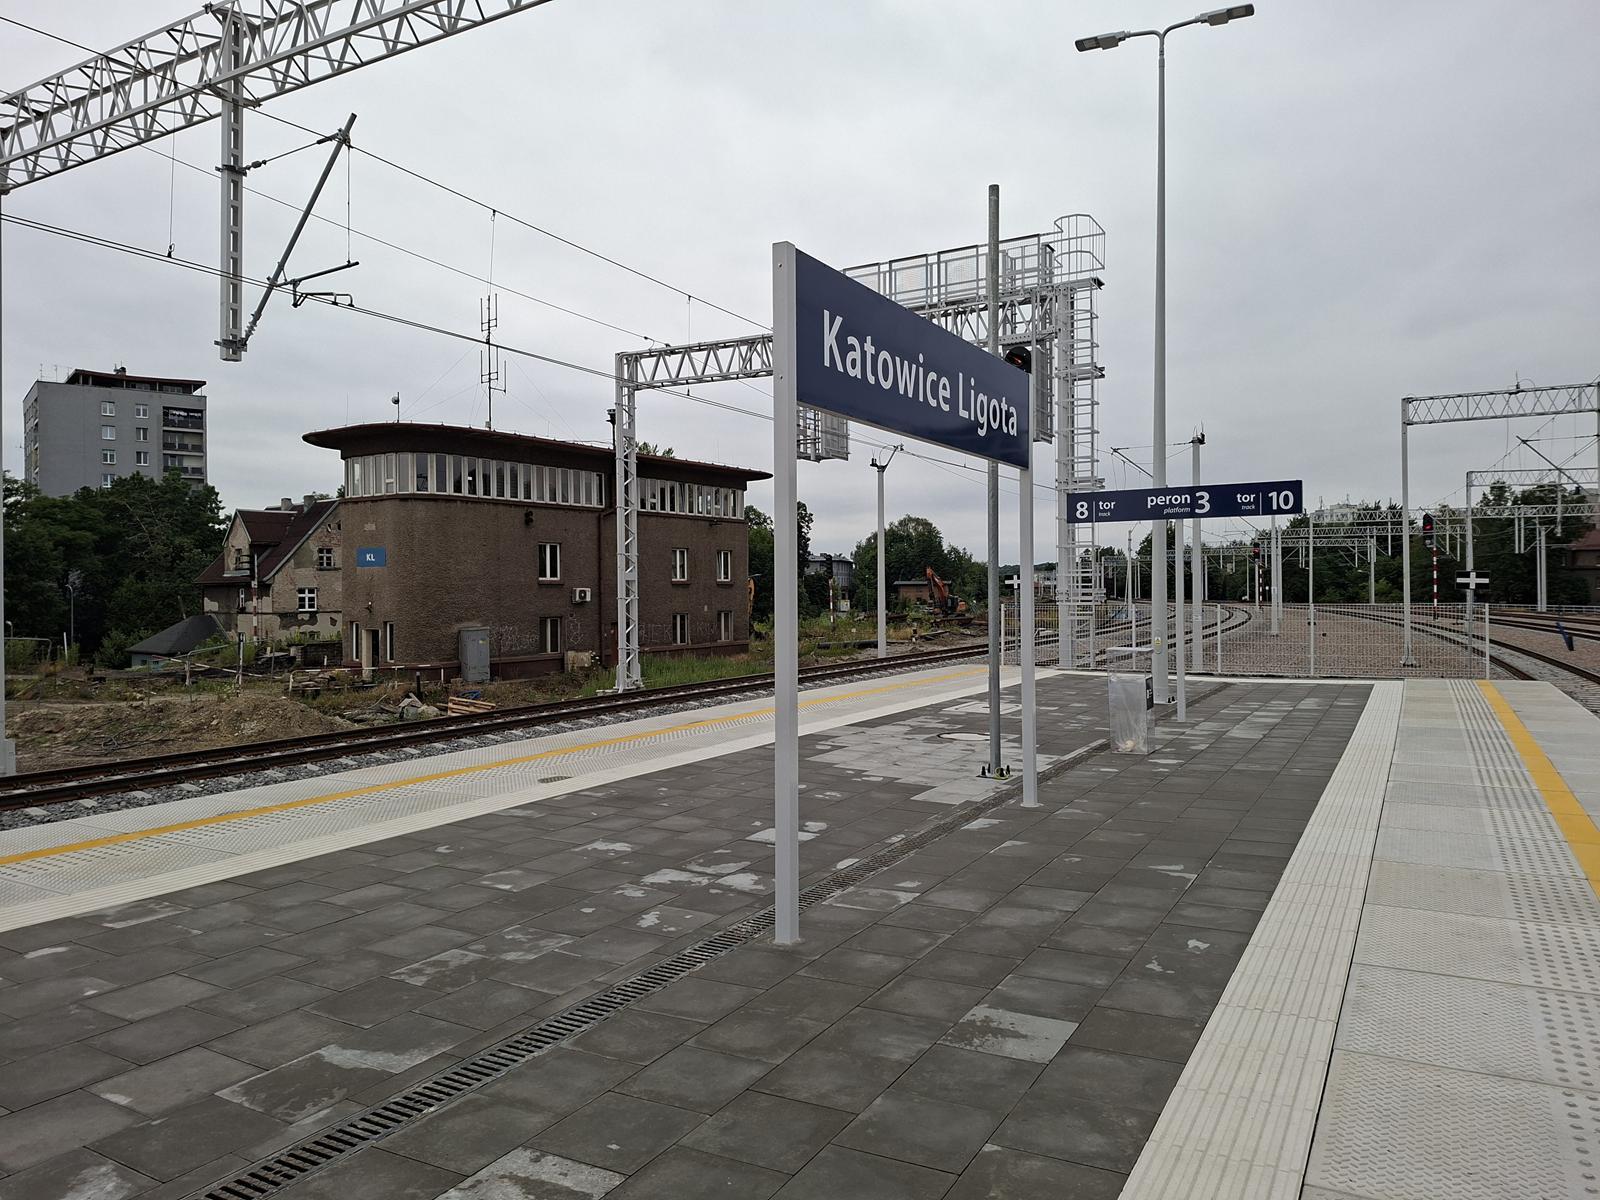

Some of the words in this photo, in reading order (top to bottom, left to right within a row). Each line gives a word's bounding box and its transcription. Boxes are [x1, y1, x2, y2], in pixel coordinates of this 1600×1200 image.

[823, 309, 950, 412] Katowice
[958, 371, 1018, 437] Ligota
[1147, 494, 1191, 509] peron
[1194, 491, 1211, 514] 3
[1236, 493, 1256, 503] tor
[1268, 490, 1294, 510] 10
[1075, 501, 1089, 519] 8
[1098, 501, 1116, 510] tor
[1163, 507, 1191, 515] platform
[366, 553, 375, 561] KL
